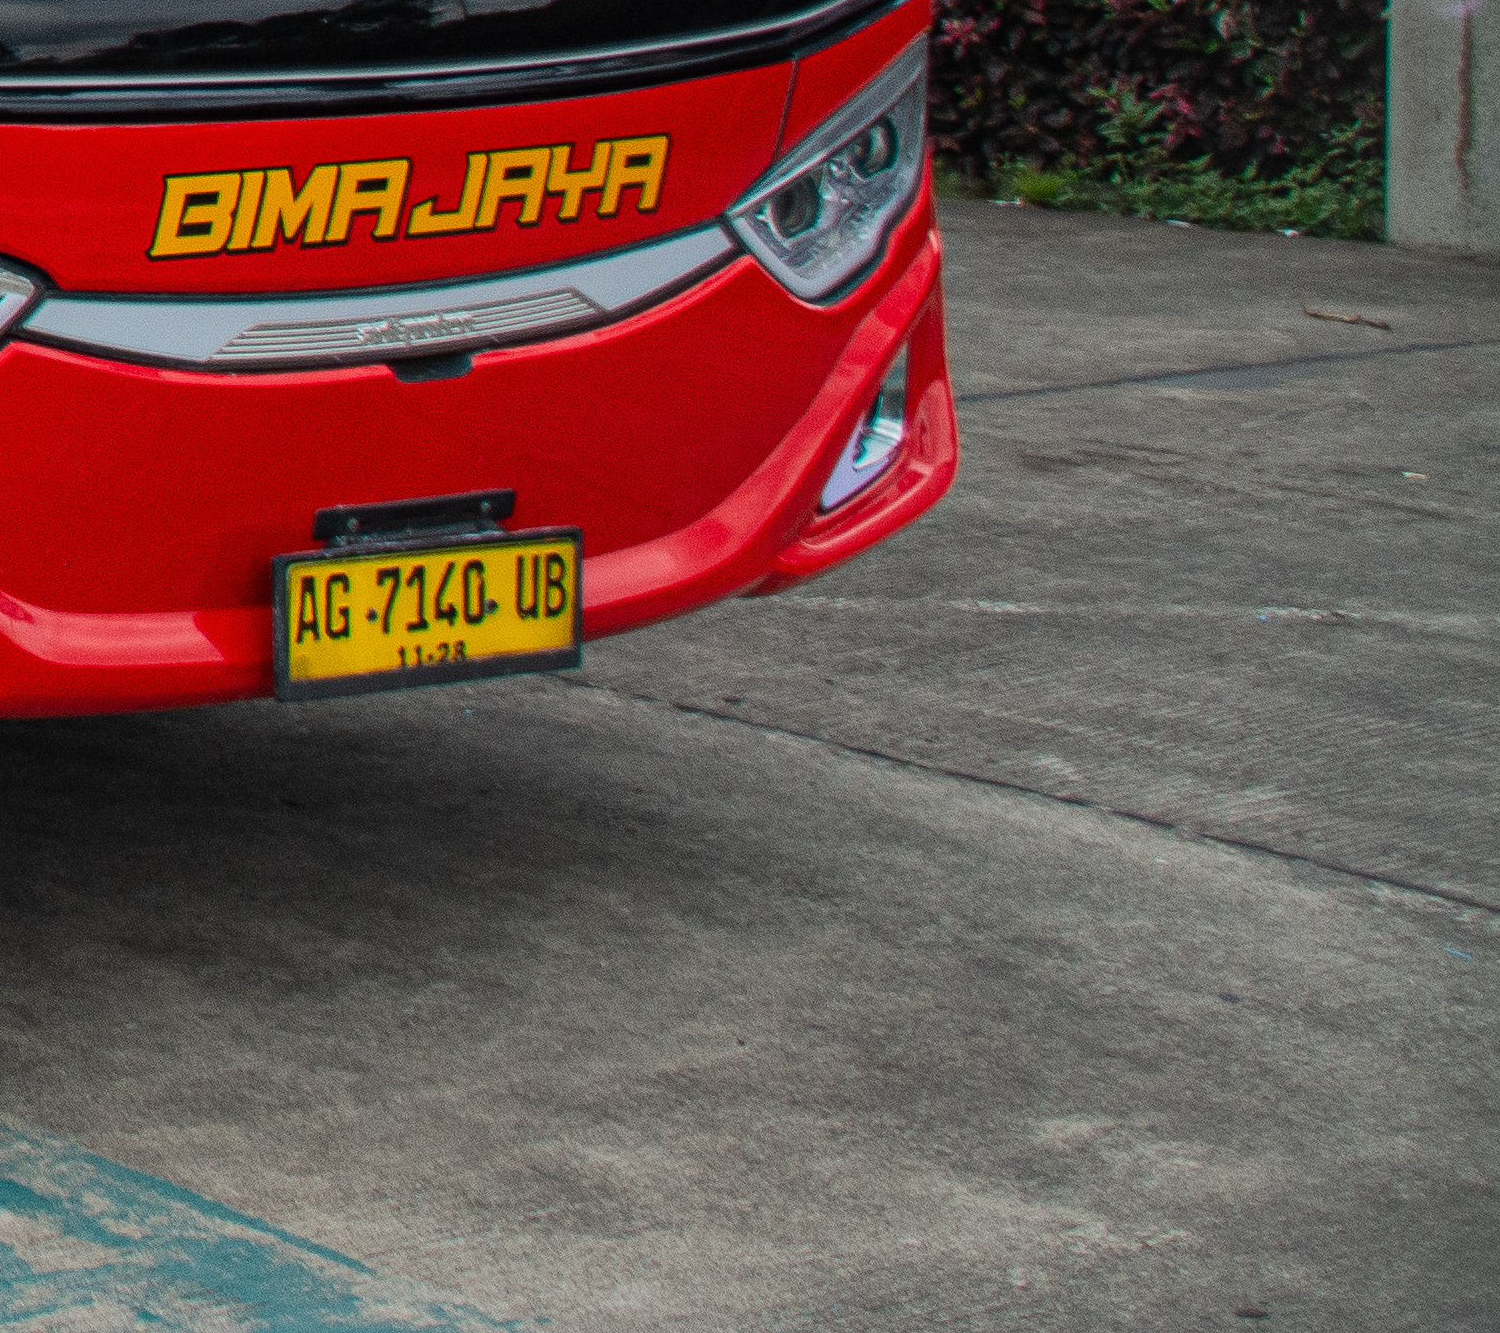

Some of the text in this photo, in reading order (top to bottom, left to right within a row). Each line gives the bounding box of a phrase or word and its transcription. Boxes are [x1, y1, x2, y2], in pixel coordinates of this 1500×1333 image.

[146, 134, 671, 261] BIMA JAYA
[296, 551, 567, 644] AG 7140 UB
